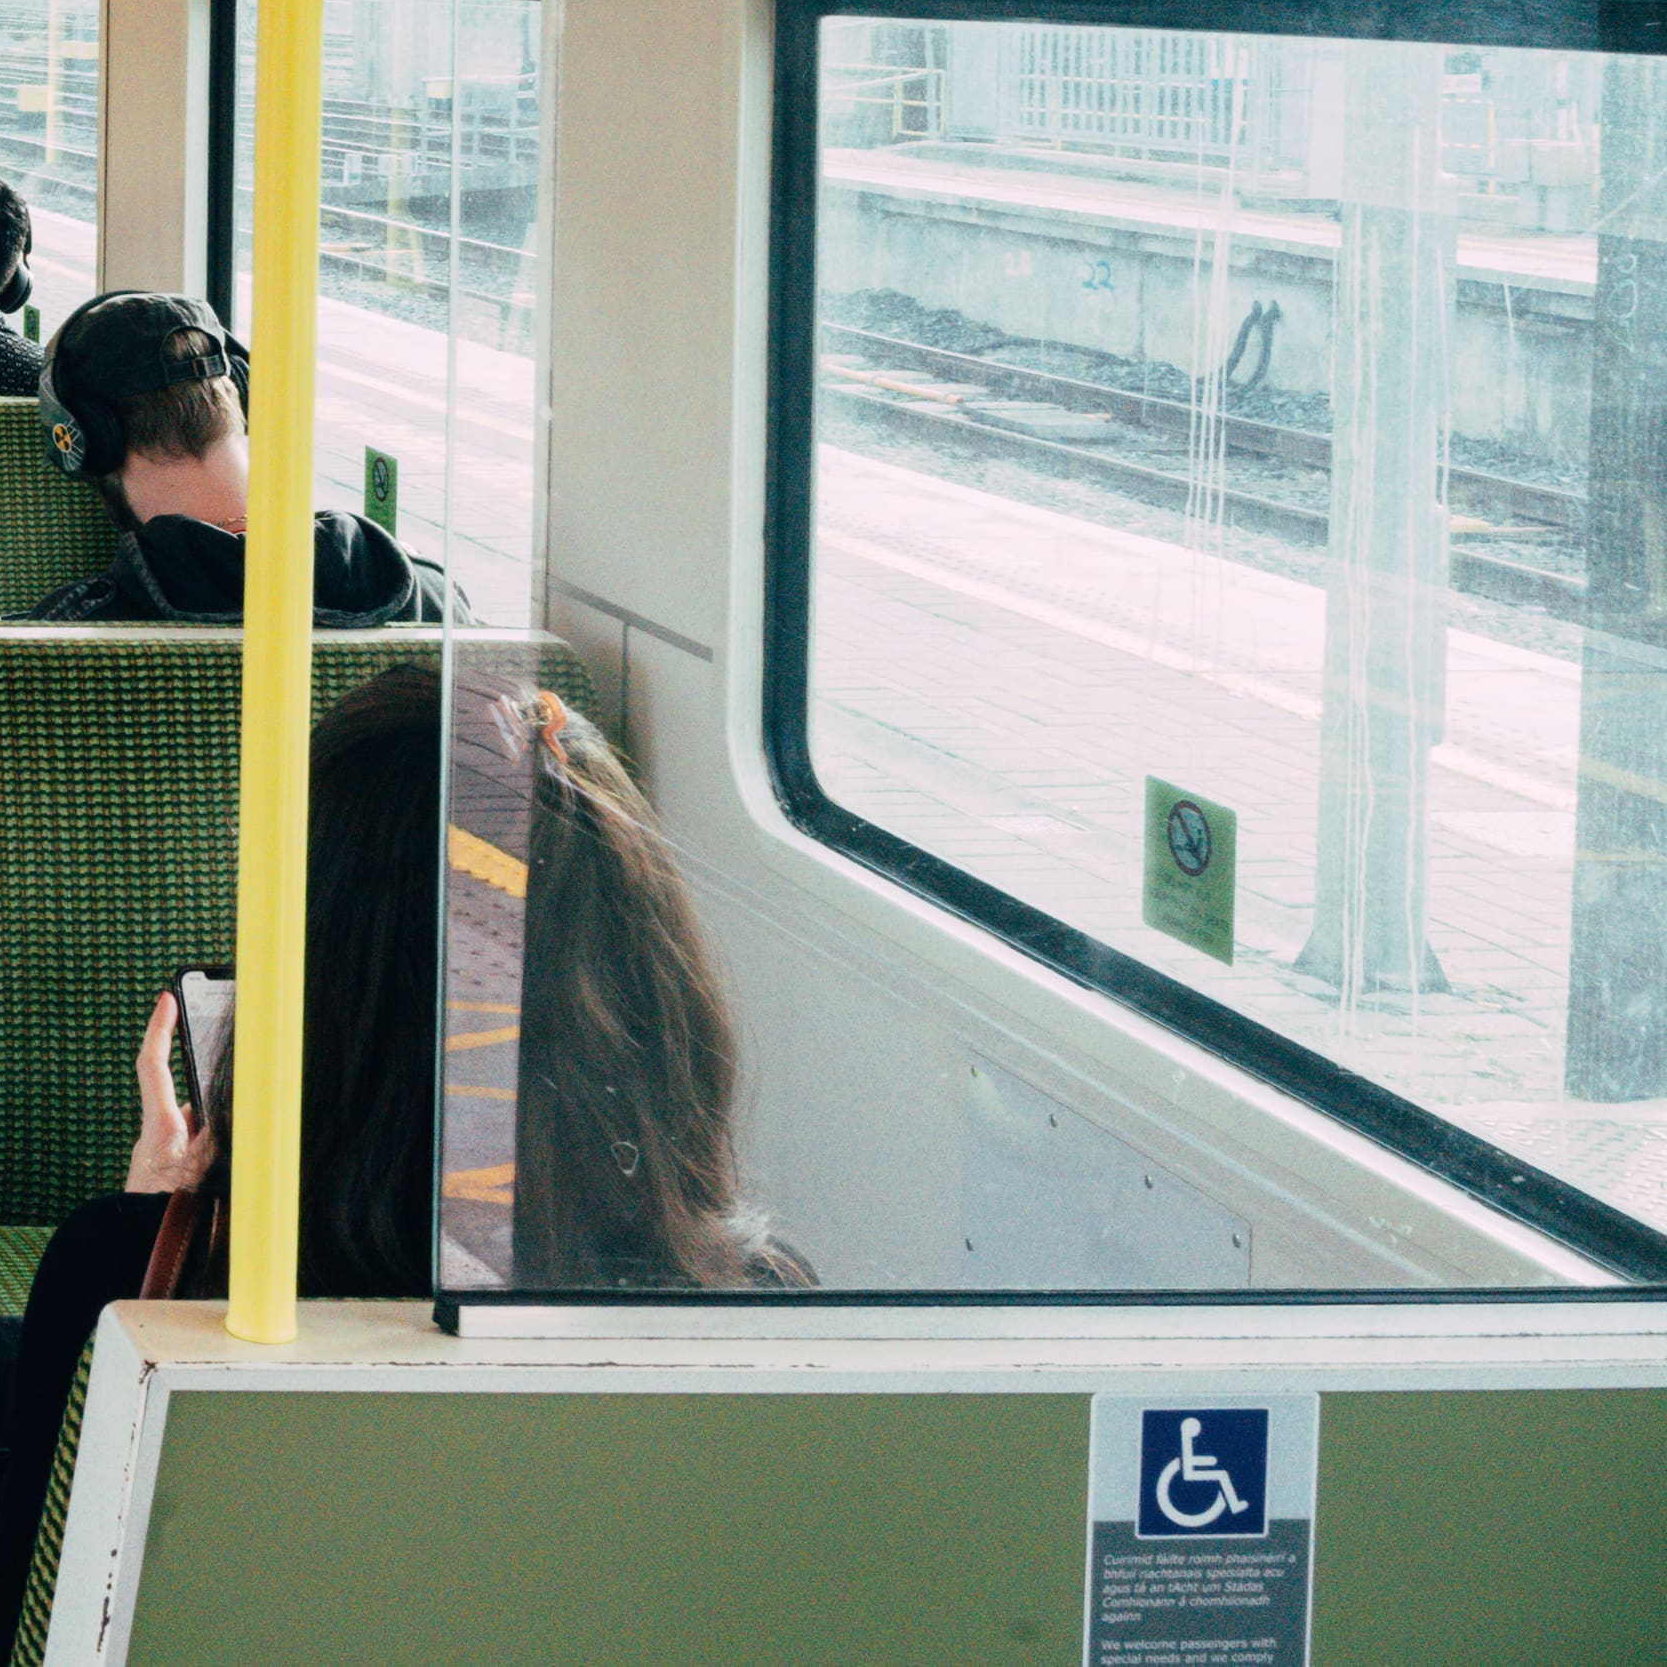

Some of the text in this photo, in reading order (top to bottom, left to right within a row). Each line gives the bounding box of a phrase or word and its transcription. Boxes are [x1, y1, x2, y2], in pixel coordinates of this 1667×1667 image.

[1101, 1638, 1277, 1650] We welcome passengers with
[1100, 1653, 1274, 1665] special needs and we comply
